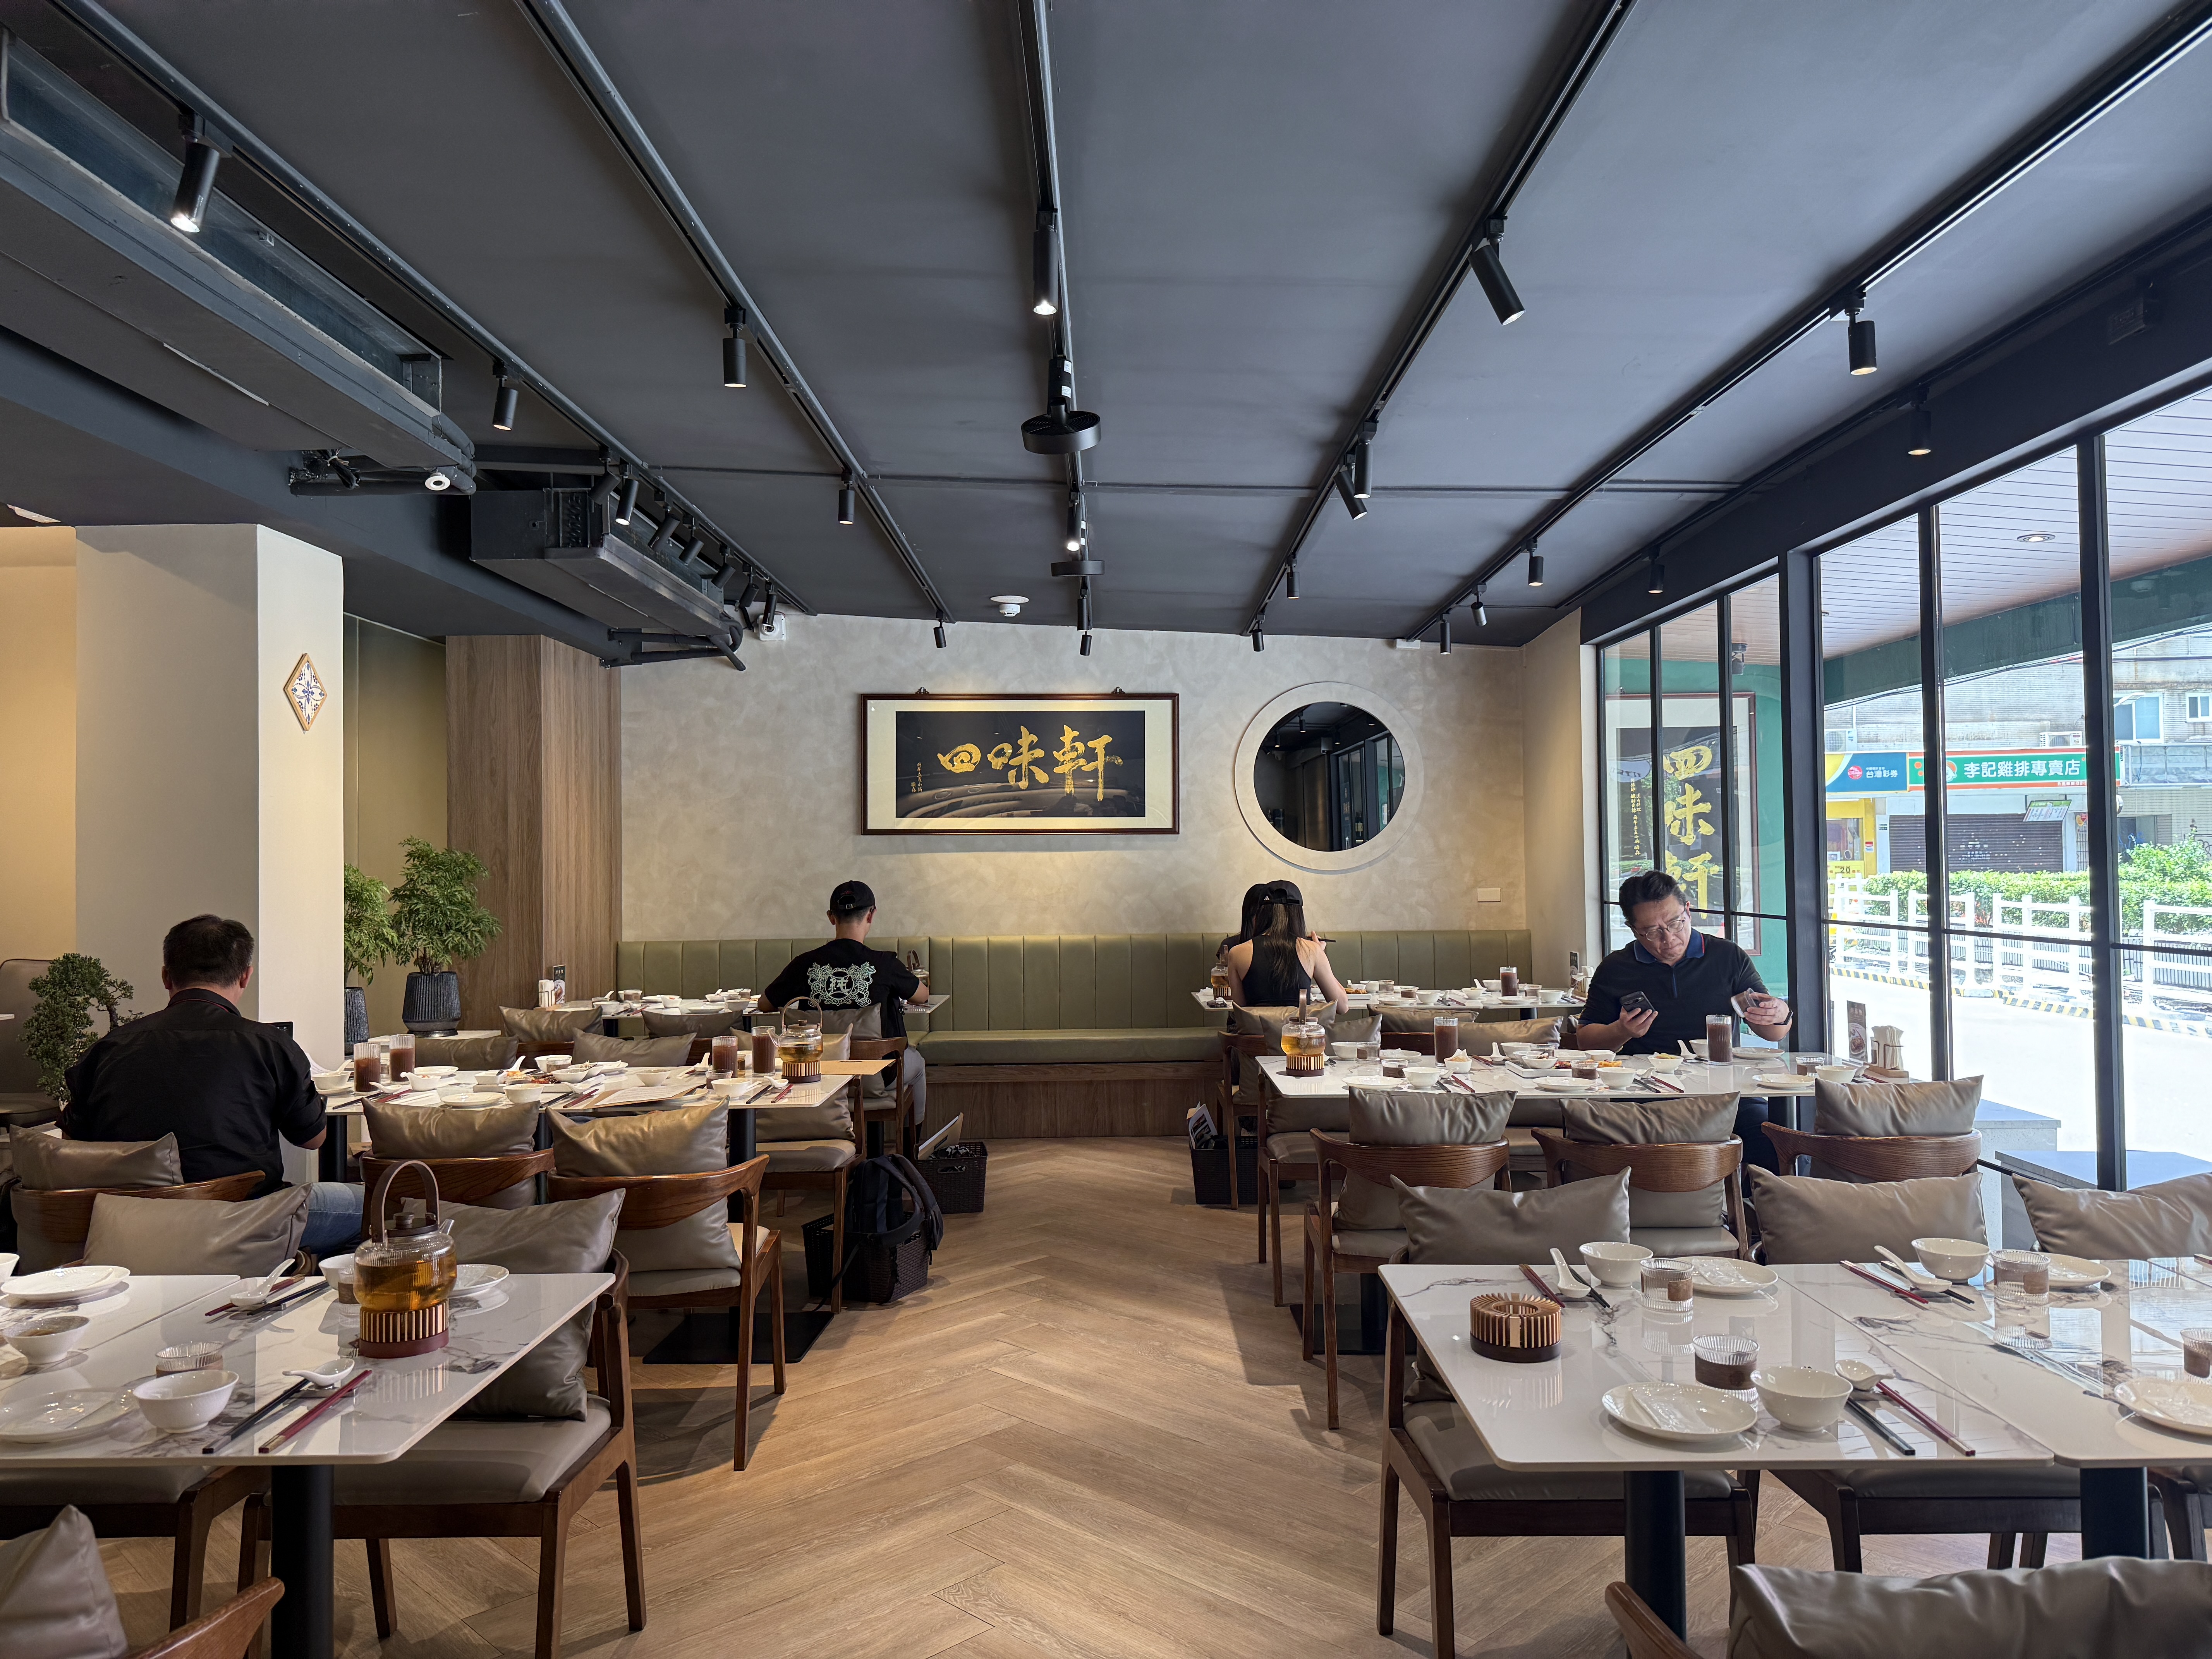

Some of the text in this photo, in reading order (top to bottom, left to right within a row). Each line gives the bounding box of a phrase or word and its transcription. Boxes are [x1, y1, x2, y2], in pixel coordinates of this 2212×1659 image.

[1866, 769, 1898, 778] 台灣彩券
[1964, 759, 2080, 778] 李記雞排專賣店
